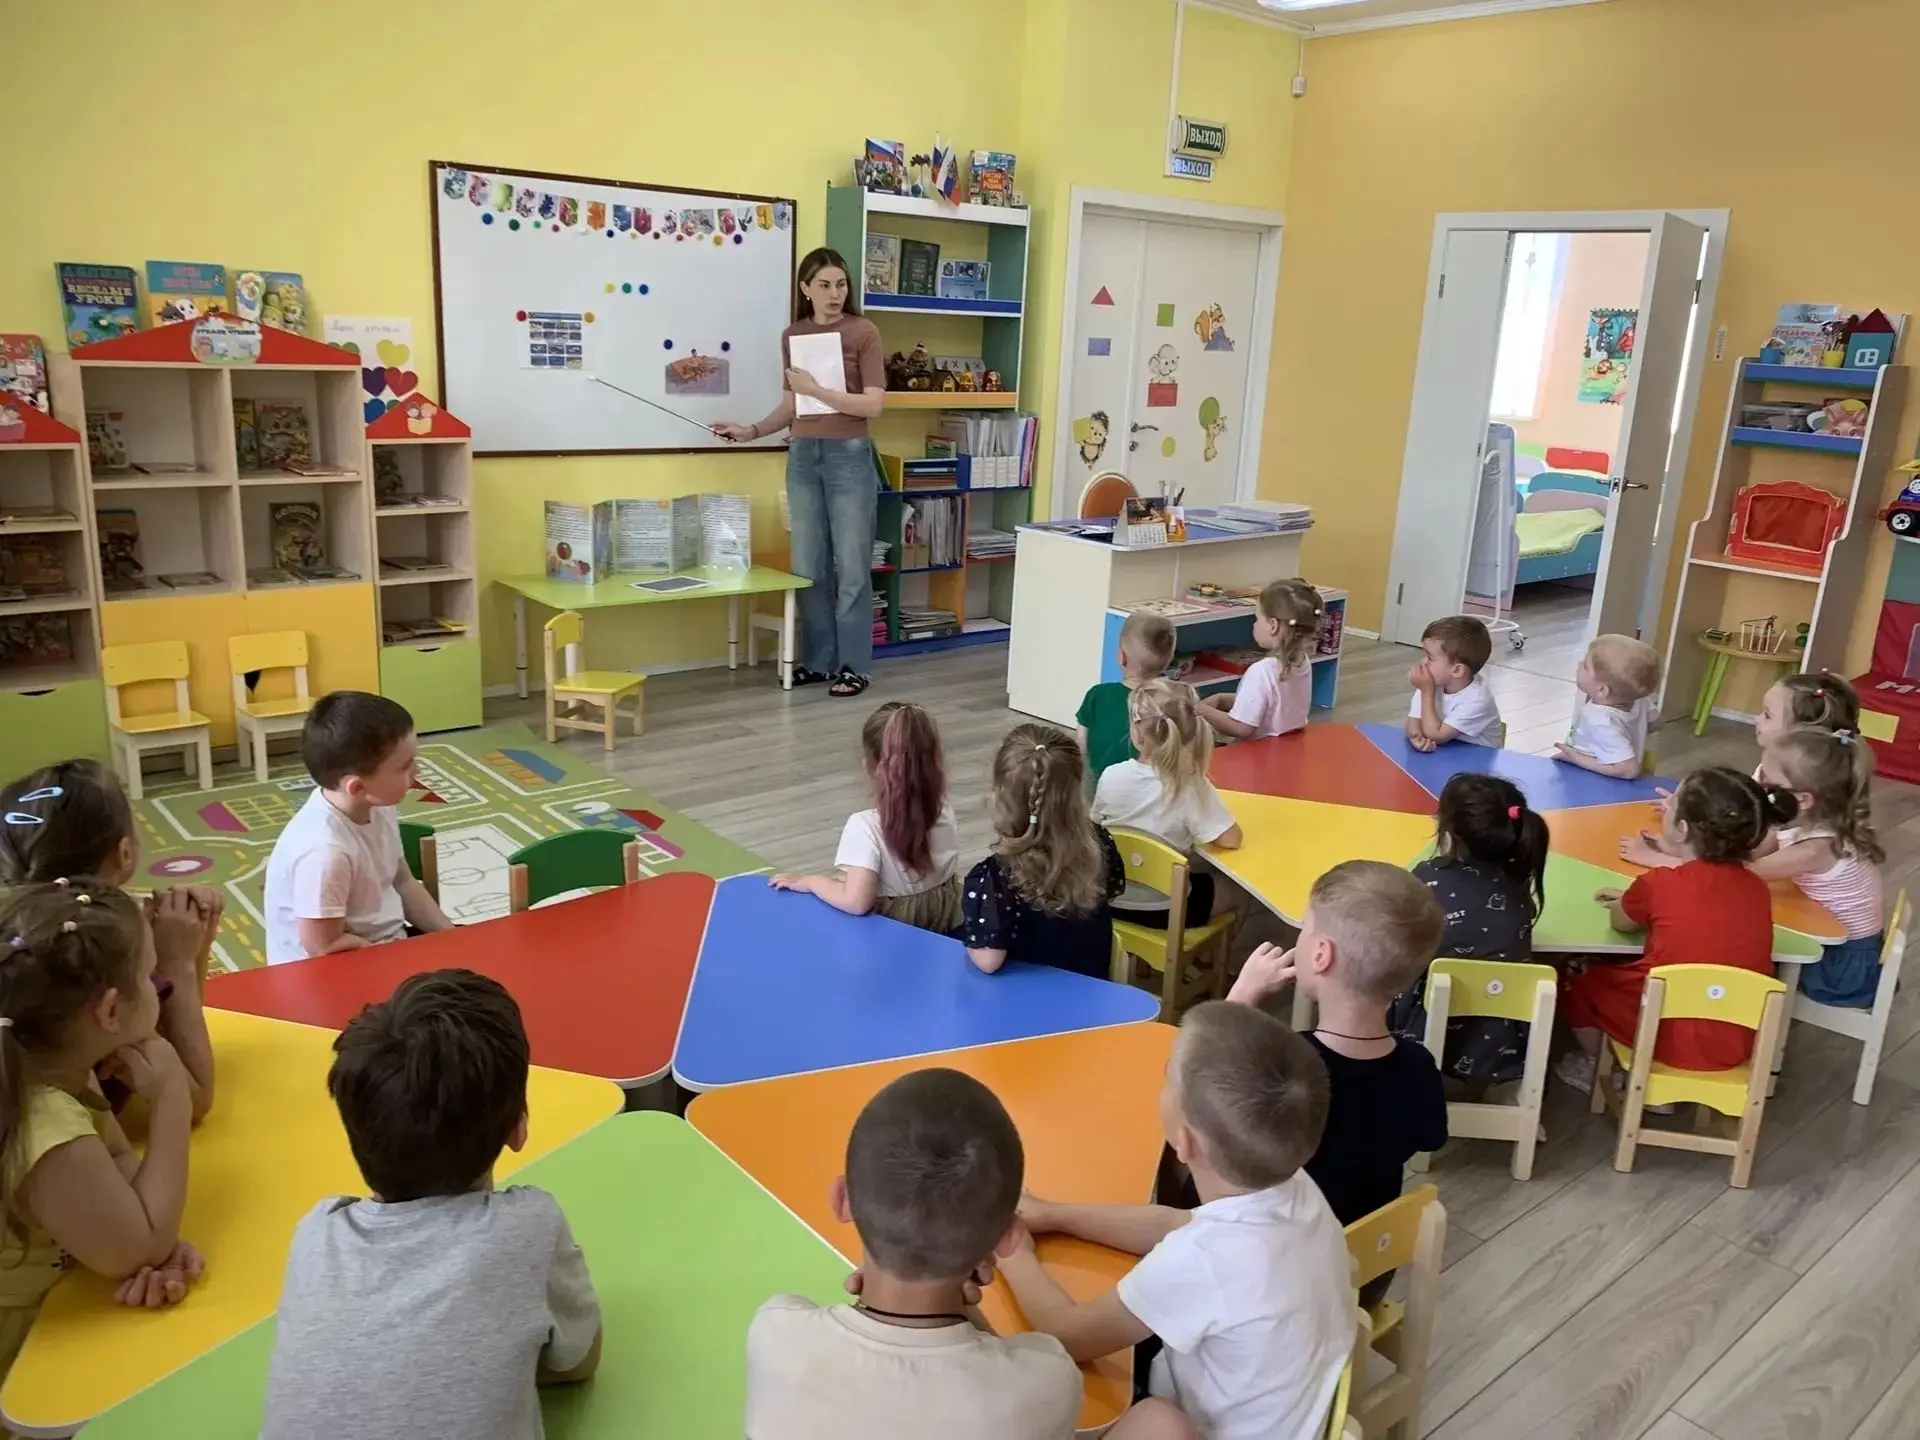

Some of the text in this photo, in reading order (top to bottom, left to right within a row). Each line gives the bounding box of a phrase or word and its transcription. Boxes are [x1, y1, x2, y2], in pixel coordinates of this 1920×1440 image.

[1190, 127, 1222, 149] ВЫХОД
[1174, 158, 1210, 177] ВЫХОД
[75, 293, 125, 305] УРОКИ
